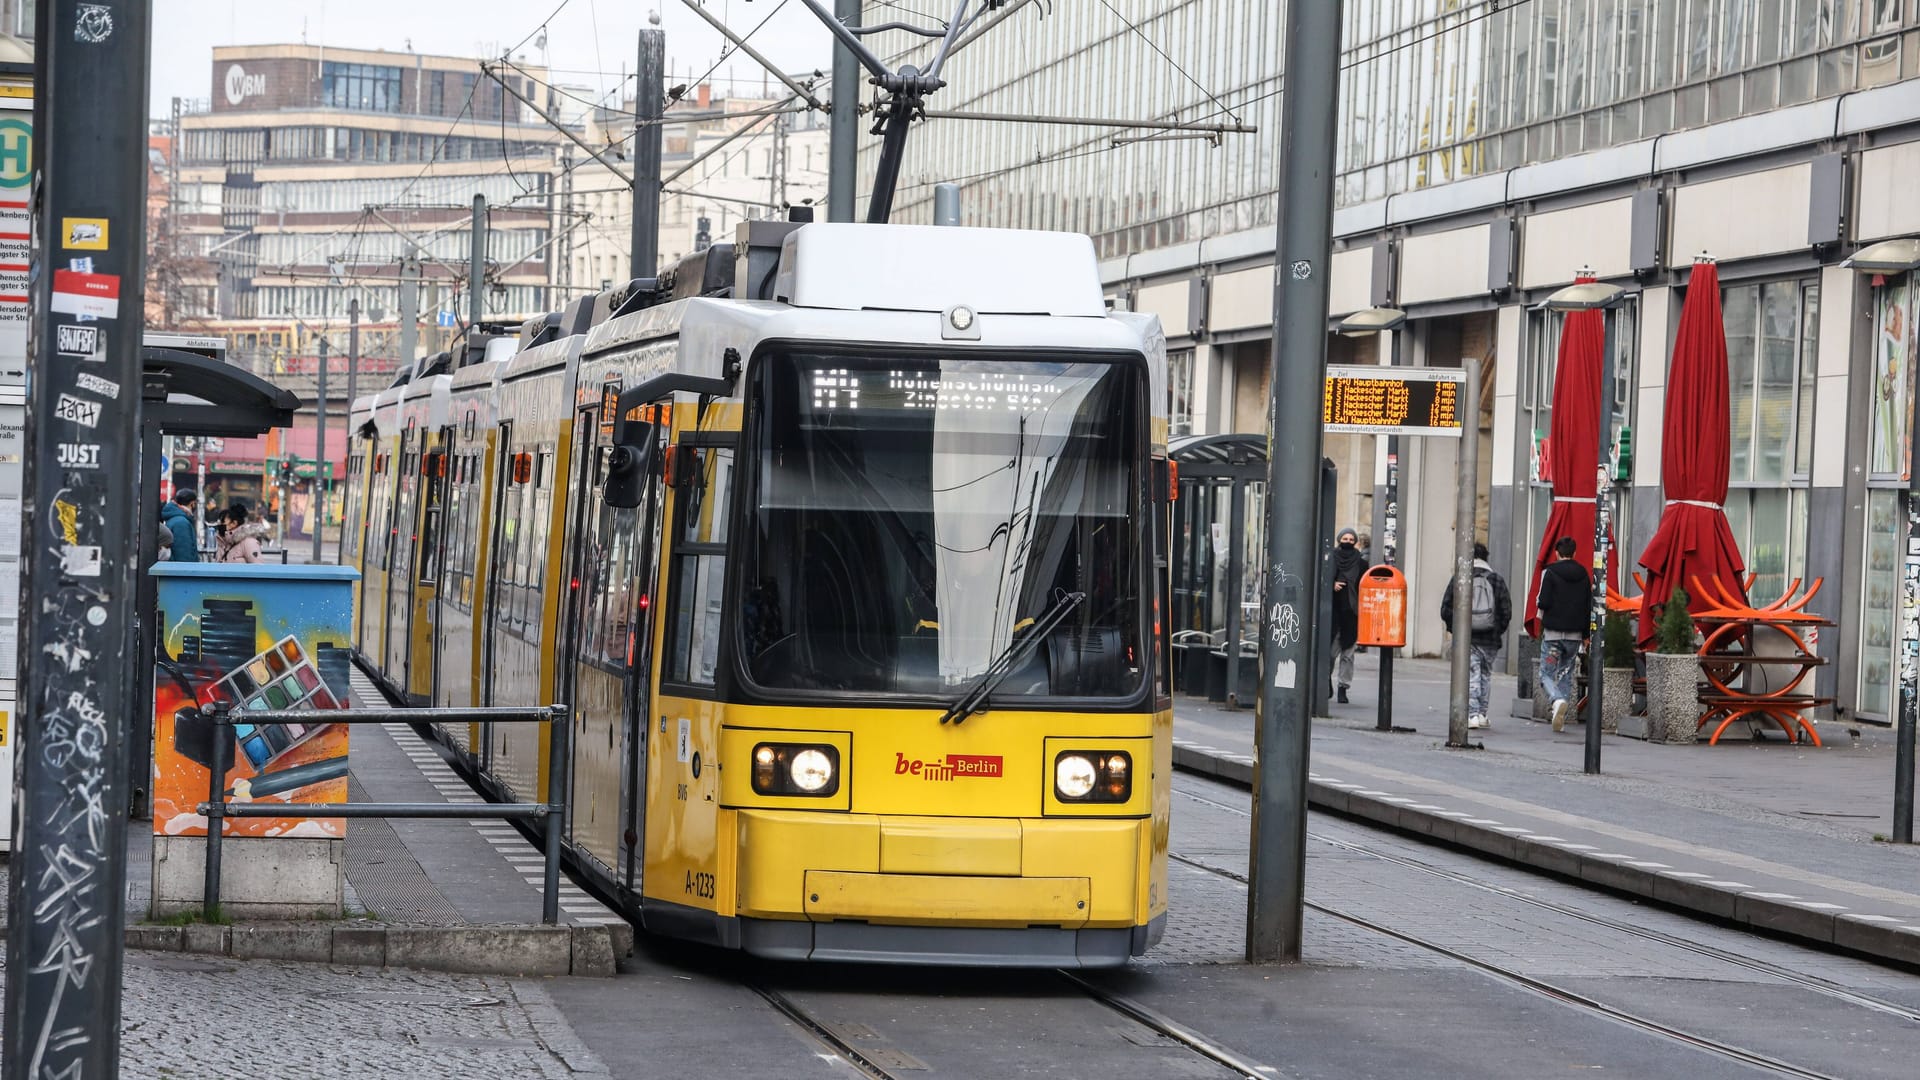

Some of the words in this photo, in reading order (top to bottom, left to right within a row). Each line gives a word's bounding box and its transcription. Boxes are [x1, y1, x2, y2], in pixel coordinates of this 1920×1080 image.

[230, 72, 266, 98] WBM
[1354, 378, 1404, 387] Hauptbahnhof
[1344, 385, 1385, 394] Hackescher
[1388, 387, 1409, 395] Markt
[1442, 389, 1456, 397] min
[1344, 393, 1384, 402] Hackescher
[1387, 395, 1409, 403] Markt
[1441, 396, 1455, 404] min
[1343, 401, 1384, 410] Hackescher
[1387, 402, 1409, 411] Markt
[1441, 404, 1455, 412] min
[1343, 408, 1383, 417] Hackescher
[1386, 410, 1408, 418] Markt
[1440, 412, 1454, 420] min
[1351, 417, 1401, 425] Hauptbahnhof
[1440, 419, 1454, 427] min
[57, 444, 100, 464] JUST
[895, 752, 923, 775] be
[957, 759, 998, 774] Berlin
[677, 784, 688, 801] BVG
[685, 870, 715, 899] A-1233
